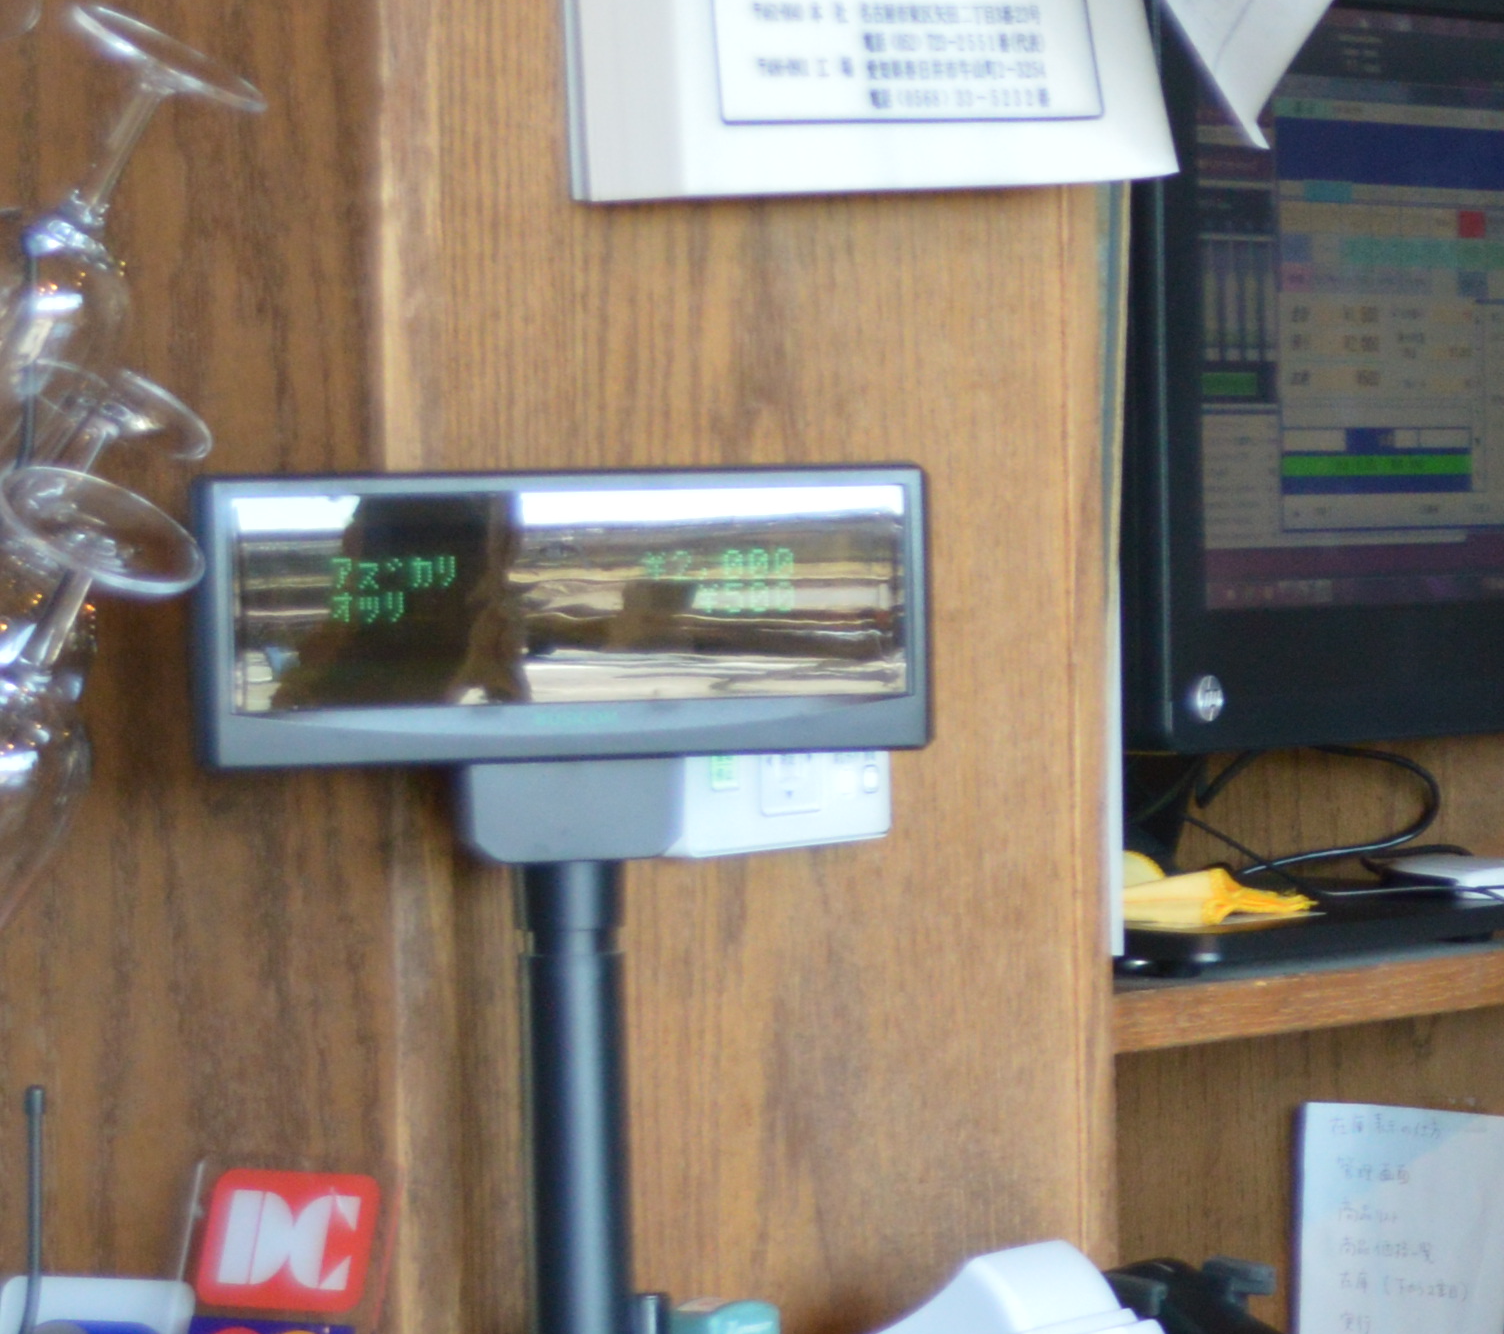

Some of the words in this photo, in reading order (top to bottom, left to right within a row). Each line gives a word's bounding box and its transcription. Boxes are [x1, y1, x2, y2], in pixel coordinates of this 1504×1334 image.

[331, 591, 407, 624] オツリ
[216, 1187, 362, 1291] DC
